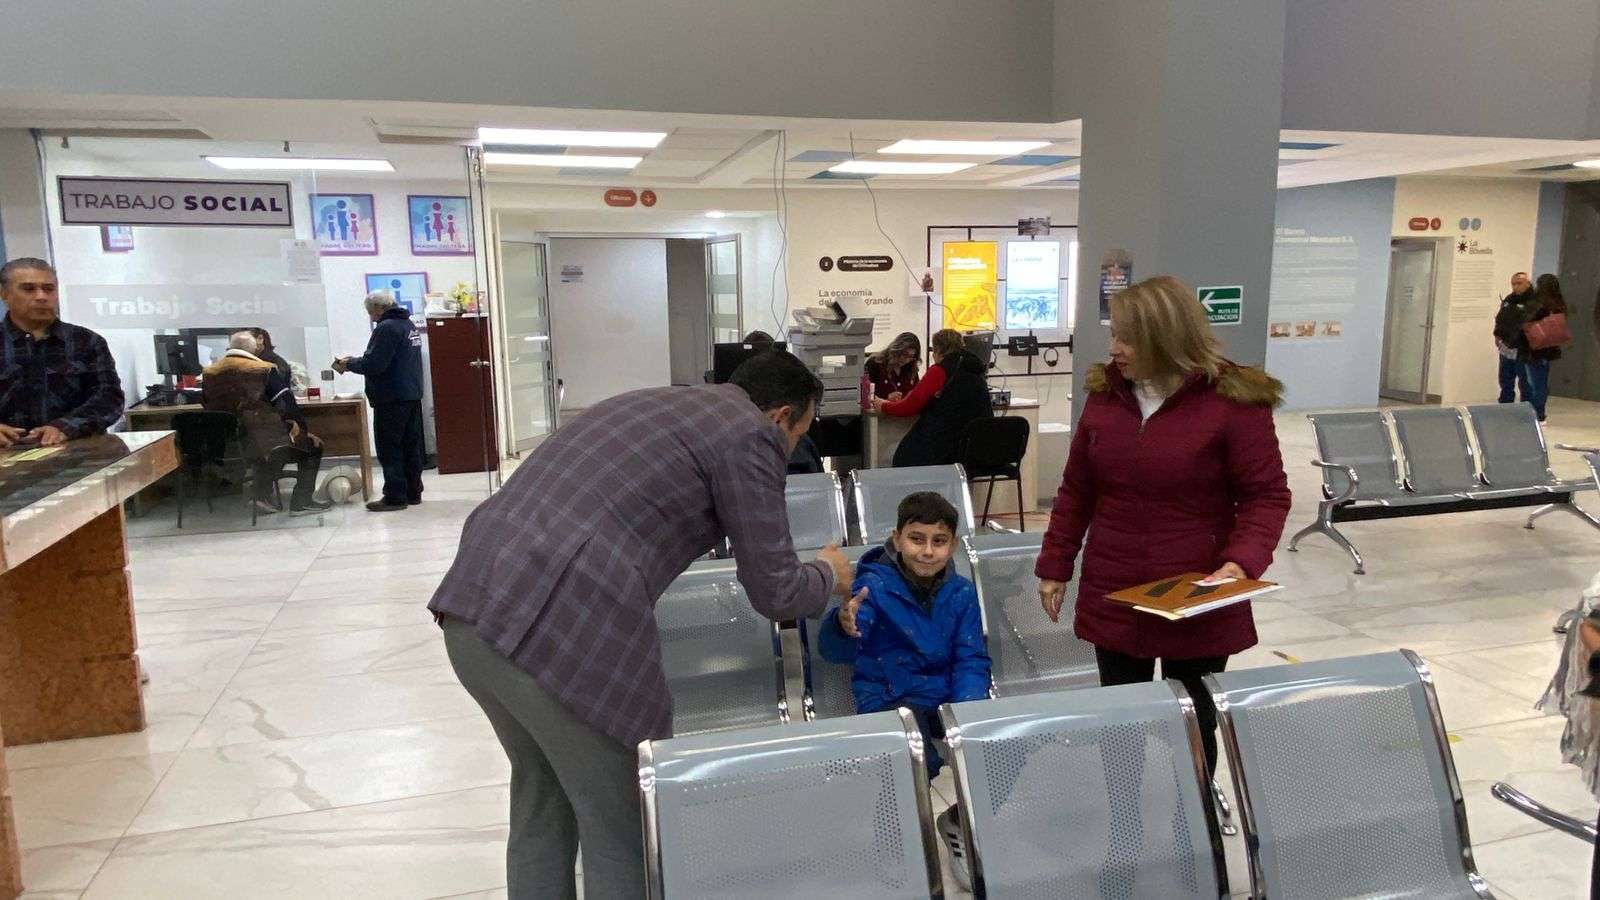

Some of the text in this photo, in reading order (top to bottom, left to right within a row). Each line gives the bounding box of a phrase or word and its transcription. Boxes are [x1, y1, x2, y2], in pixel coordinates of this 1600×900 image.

[69, 193, 284, 212] TRABAJO SOCIAL
[818, 289, 829, 298] La
[864, 297, 894, 306] grande
